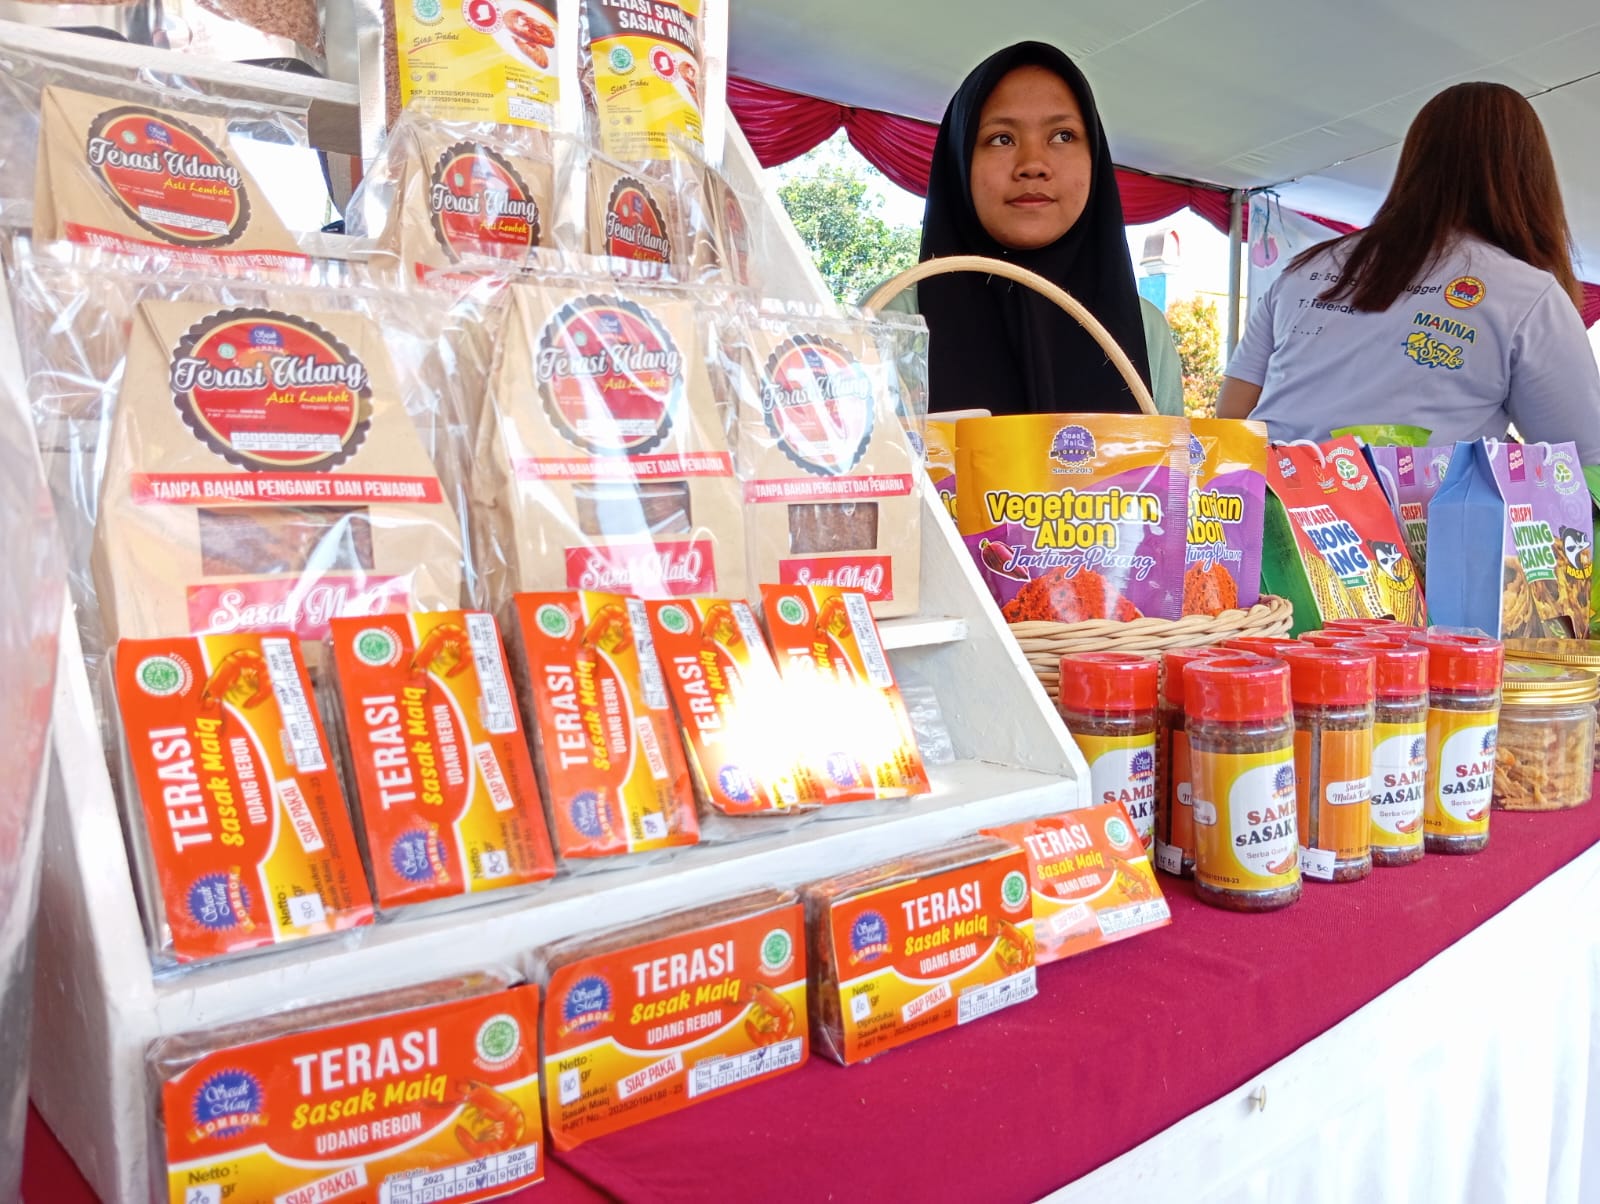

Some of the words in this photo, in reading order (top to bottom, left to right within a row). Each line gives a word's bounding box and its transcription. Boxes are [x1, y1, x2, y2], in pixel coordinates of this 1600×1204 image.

[618, 11, 665, 35] SASAK
[88, 137, 162, 171] Terasi
[163, 151, 241, 186] Udang
[190, 181, 231, 196] Lombok
[432, 183, 480, 214] Terasi
[484, 190, 537, 224] Udang
[85, 231, 122, 250] TANPA
[223, 254, 249, 267] DAN
[607, 211, 635, 242] Terasi
[637, 223, 669, 258] Udang
[1405, 283, 1443, 297] ugget
[1413, 312, 1476, 344] MANNA
[173, 356, 266, 391] Terasi
[269, 355, 367, 391] Udang
[610, 343, 679, 376] Udang
[299, 390, 349, 404] Lombok
[660, 459, 680, 473] DAN
[1052, 466, 1074, 474] Since
[151, 479, 201, 498] TANPA
[204, 480, 255, 498] BAHAN
[258, 480, 332, 497] PENGAWET
[334, 480, 363, 497] DAN
[365, 482, 427, 498] PEWARNA
[755, 485, 783, 497] TANPA
[784, 483, 812, 496] BAHAN
[813, 481, 854, 494] PENGAWET
[854, 480, 870, 491] DAN
[870, 478, 905, 491] PEWARNA
[987, 489, 1159, 527] Vegetarian
[1510, 505, 1532, 522] CRISPY
[1036, 520, 1116, 550] Abon
[576, 660, 598, 708] Maiq
[700, 650, 726, 690] Maiq
[403, 686, 429, 736] Maiq
[601, 678, 621, 716] REBON
[673, 656, 722, 747] TERASI
[432, 704, 456, 744] REBON
[546, 664, 588, 770] TERASI
[608, 716, 627, 754] UDANG
[194, 717, 227, 772] Maiq
[230, 736, 256, 776] REBON
[362, 695, 416, 811] TERASI
[585, 712, 611, 771] Sasak
[411, 741, 443, 805] Sasak
[441, 745, 465, 786] UDANG
[149, 727, 213, 853] TERASI
[241, 777, 268, 826] UDANG
[280, 785, 309, 820] PAKAI
[1103, 783, 1154, 805] SAMB
[1371, 786, 1422, 805] SASAK
[1442, 775, 1491, 795] SASAK
[206, 776, 245, 848] Sasak
[1247, 799, 1296, 827] SAMB
[297, 818, 320, 846] SIAP
[1024, 824, 1093, 860] TERASI
[1235, 819, 1292, 848] SASAK
[1037, 857, 1075, 881] Sasak
[1076, 850, 1105, 869] Maiq
[1246, 851, 1270, 860] Serba
[277, 891, 294, 927] Netto
[901, 881, 982, 932] TERASI
[904, 925, 952, 957] Sasak
[953, 913, 988, 944] Maiq
[632, 940, 735, 998] TERASI
[919, 950, 949, 976] UDANG
[949, 941, 977, 966] REBON
[630, 995, 690, 1025] Sasak
[695, 978, 741, 1006] Maiq
[852, 983, 875, 996] Netto
[907, 1002, 925, 1019] SIAP
[926, 986, 947, 1009] PAKAI
[647, 1019, 685, 1045] UDANG
[686, 1009, 722, 1034] REBON
[293, 1028, 439, 1096] TERASI
[559, 1055, 588, 1072] Netto
[625, 1072, 648, 1094] SIAP
[648, 1057, 677, 1081] PAKAI
[291, 1087, 375, 1130] Sasak
[383, 1072, 447, 1106] Maiq
[195, 1113, 260, 1139] LOMBOK
[315, 1119, 369, 1155] UDANG
[371, 1112, 422, 1142] REBON
[188, 1167, 230, 1185] Netto
[317, 1170, 359, 1203] PAKAI
[423, 1173, 445, 1186] 2023
[507, 1151, 528, 1164] 2025
[221, 1183, 237, 1199] gr
